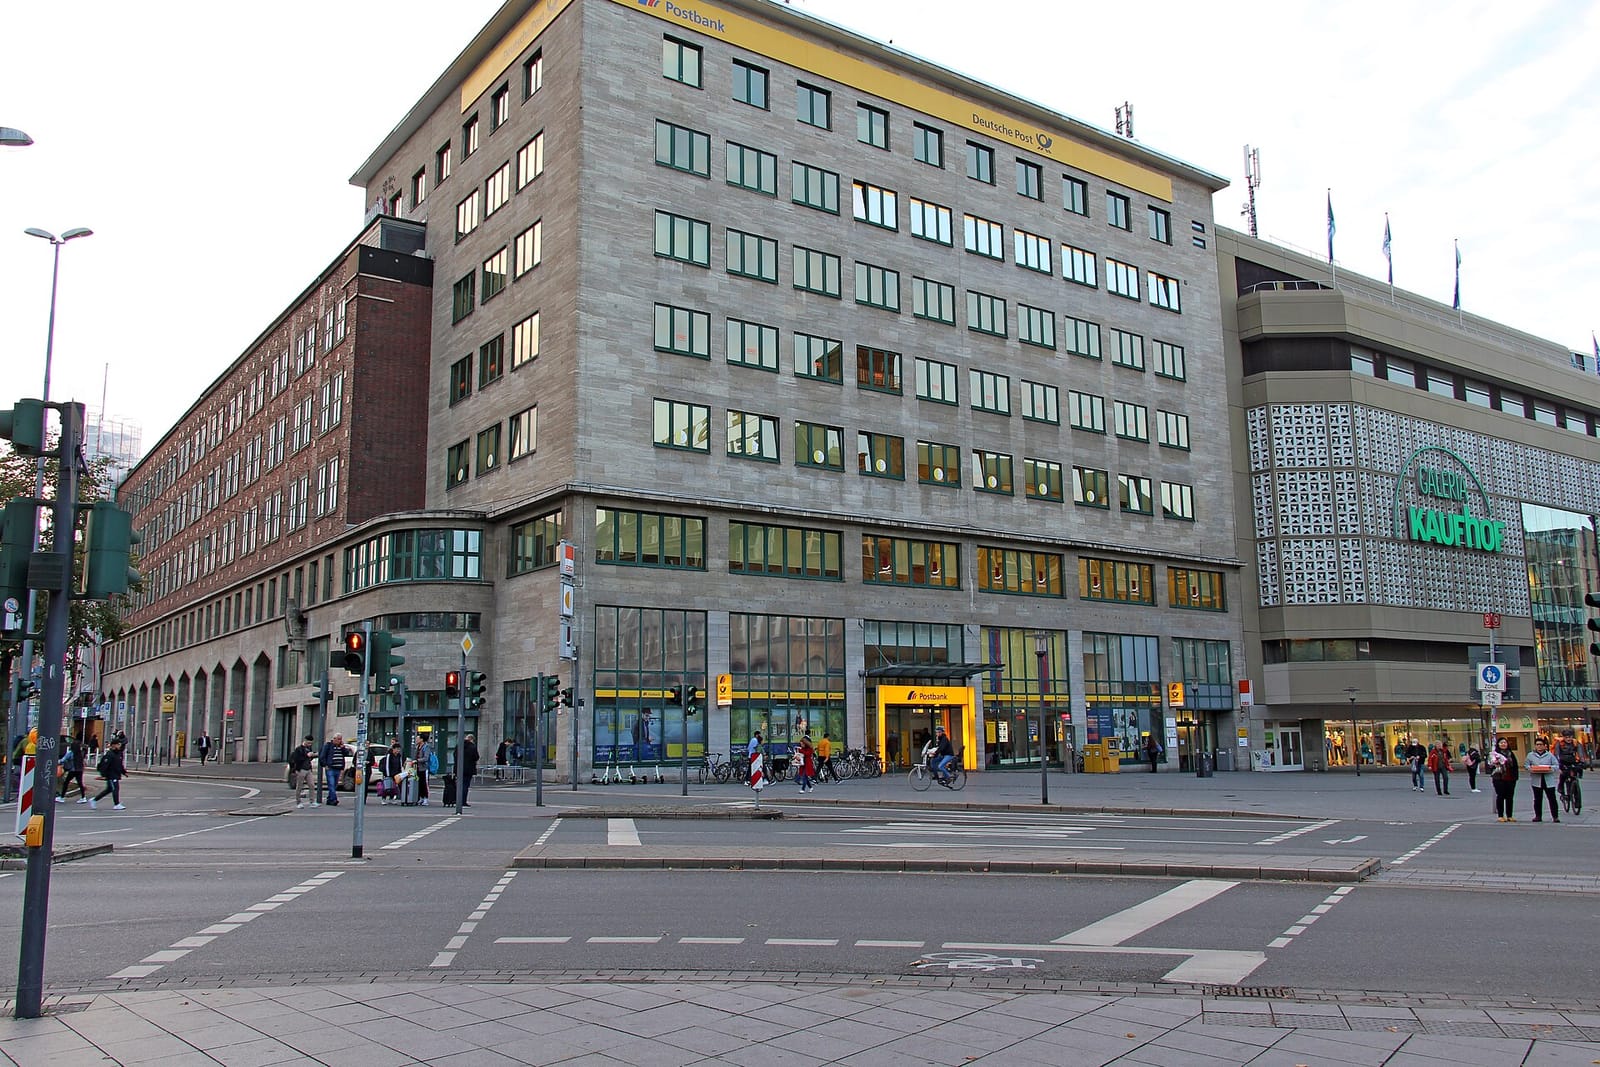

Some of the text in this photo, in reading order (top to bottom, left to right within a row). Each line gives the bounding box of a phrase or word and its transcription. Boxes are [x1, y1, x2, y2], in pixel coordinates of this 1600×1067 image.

[665, 1, 726, 32] Postbank
[972, 113, 1034, 144] Deutsche Post
[1418, 465, 1468, 503] GALERIA
[919, 692, 948, 701] Postbank
